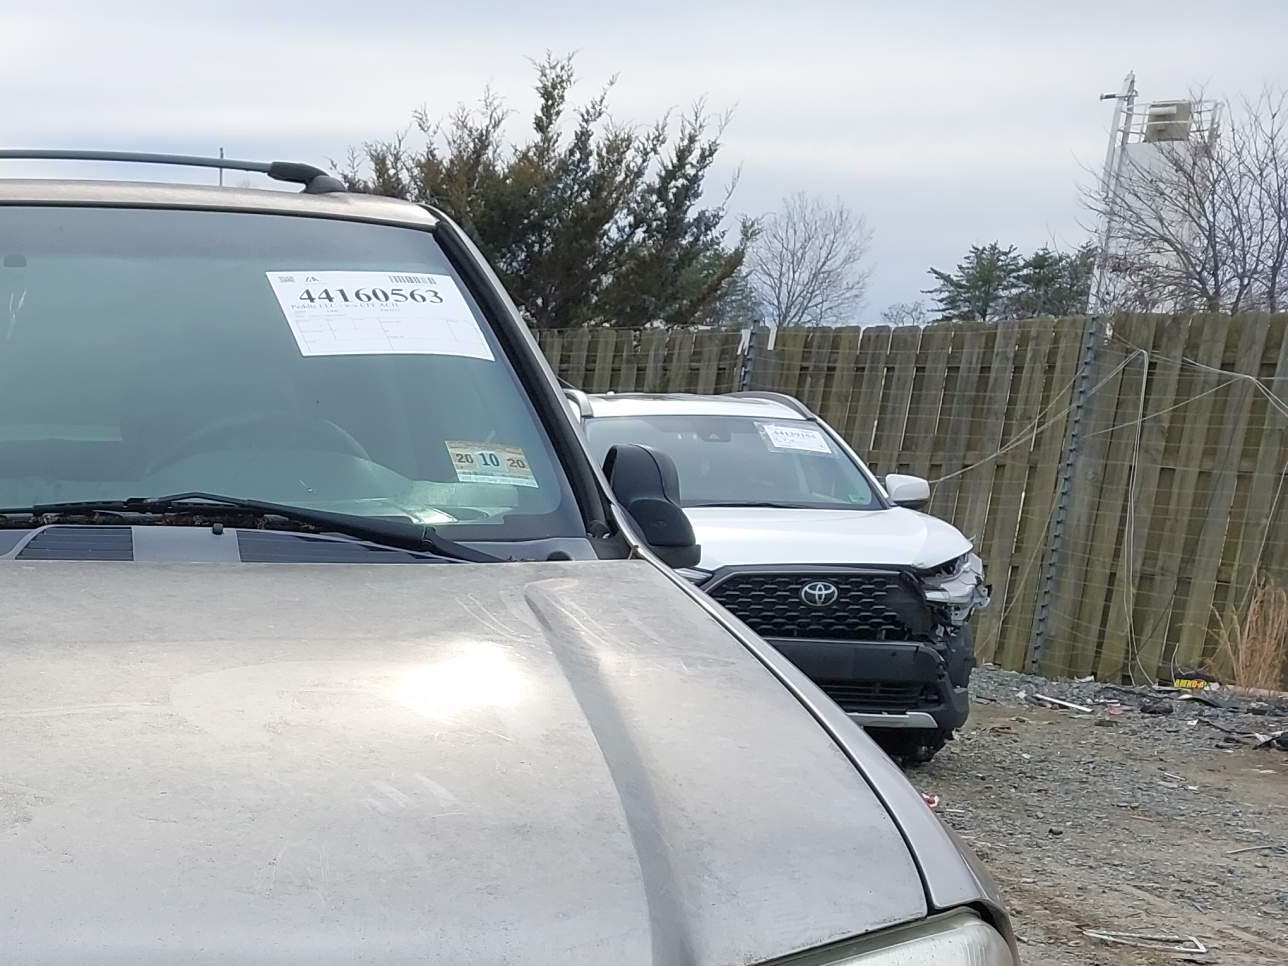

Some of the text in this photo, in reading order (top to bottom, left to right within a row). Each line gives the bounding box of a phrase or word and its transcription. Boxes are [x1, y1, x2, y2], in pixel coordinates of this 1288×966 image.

[299, 287, 444, 305] 44160563
[455, 452, 526, 469] 20 10 20
